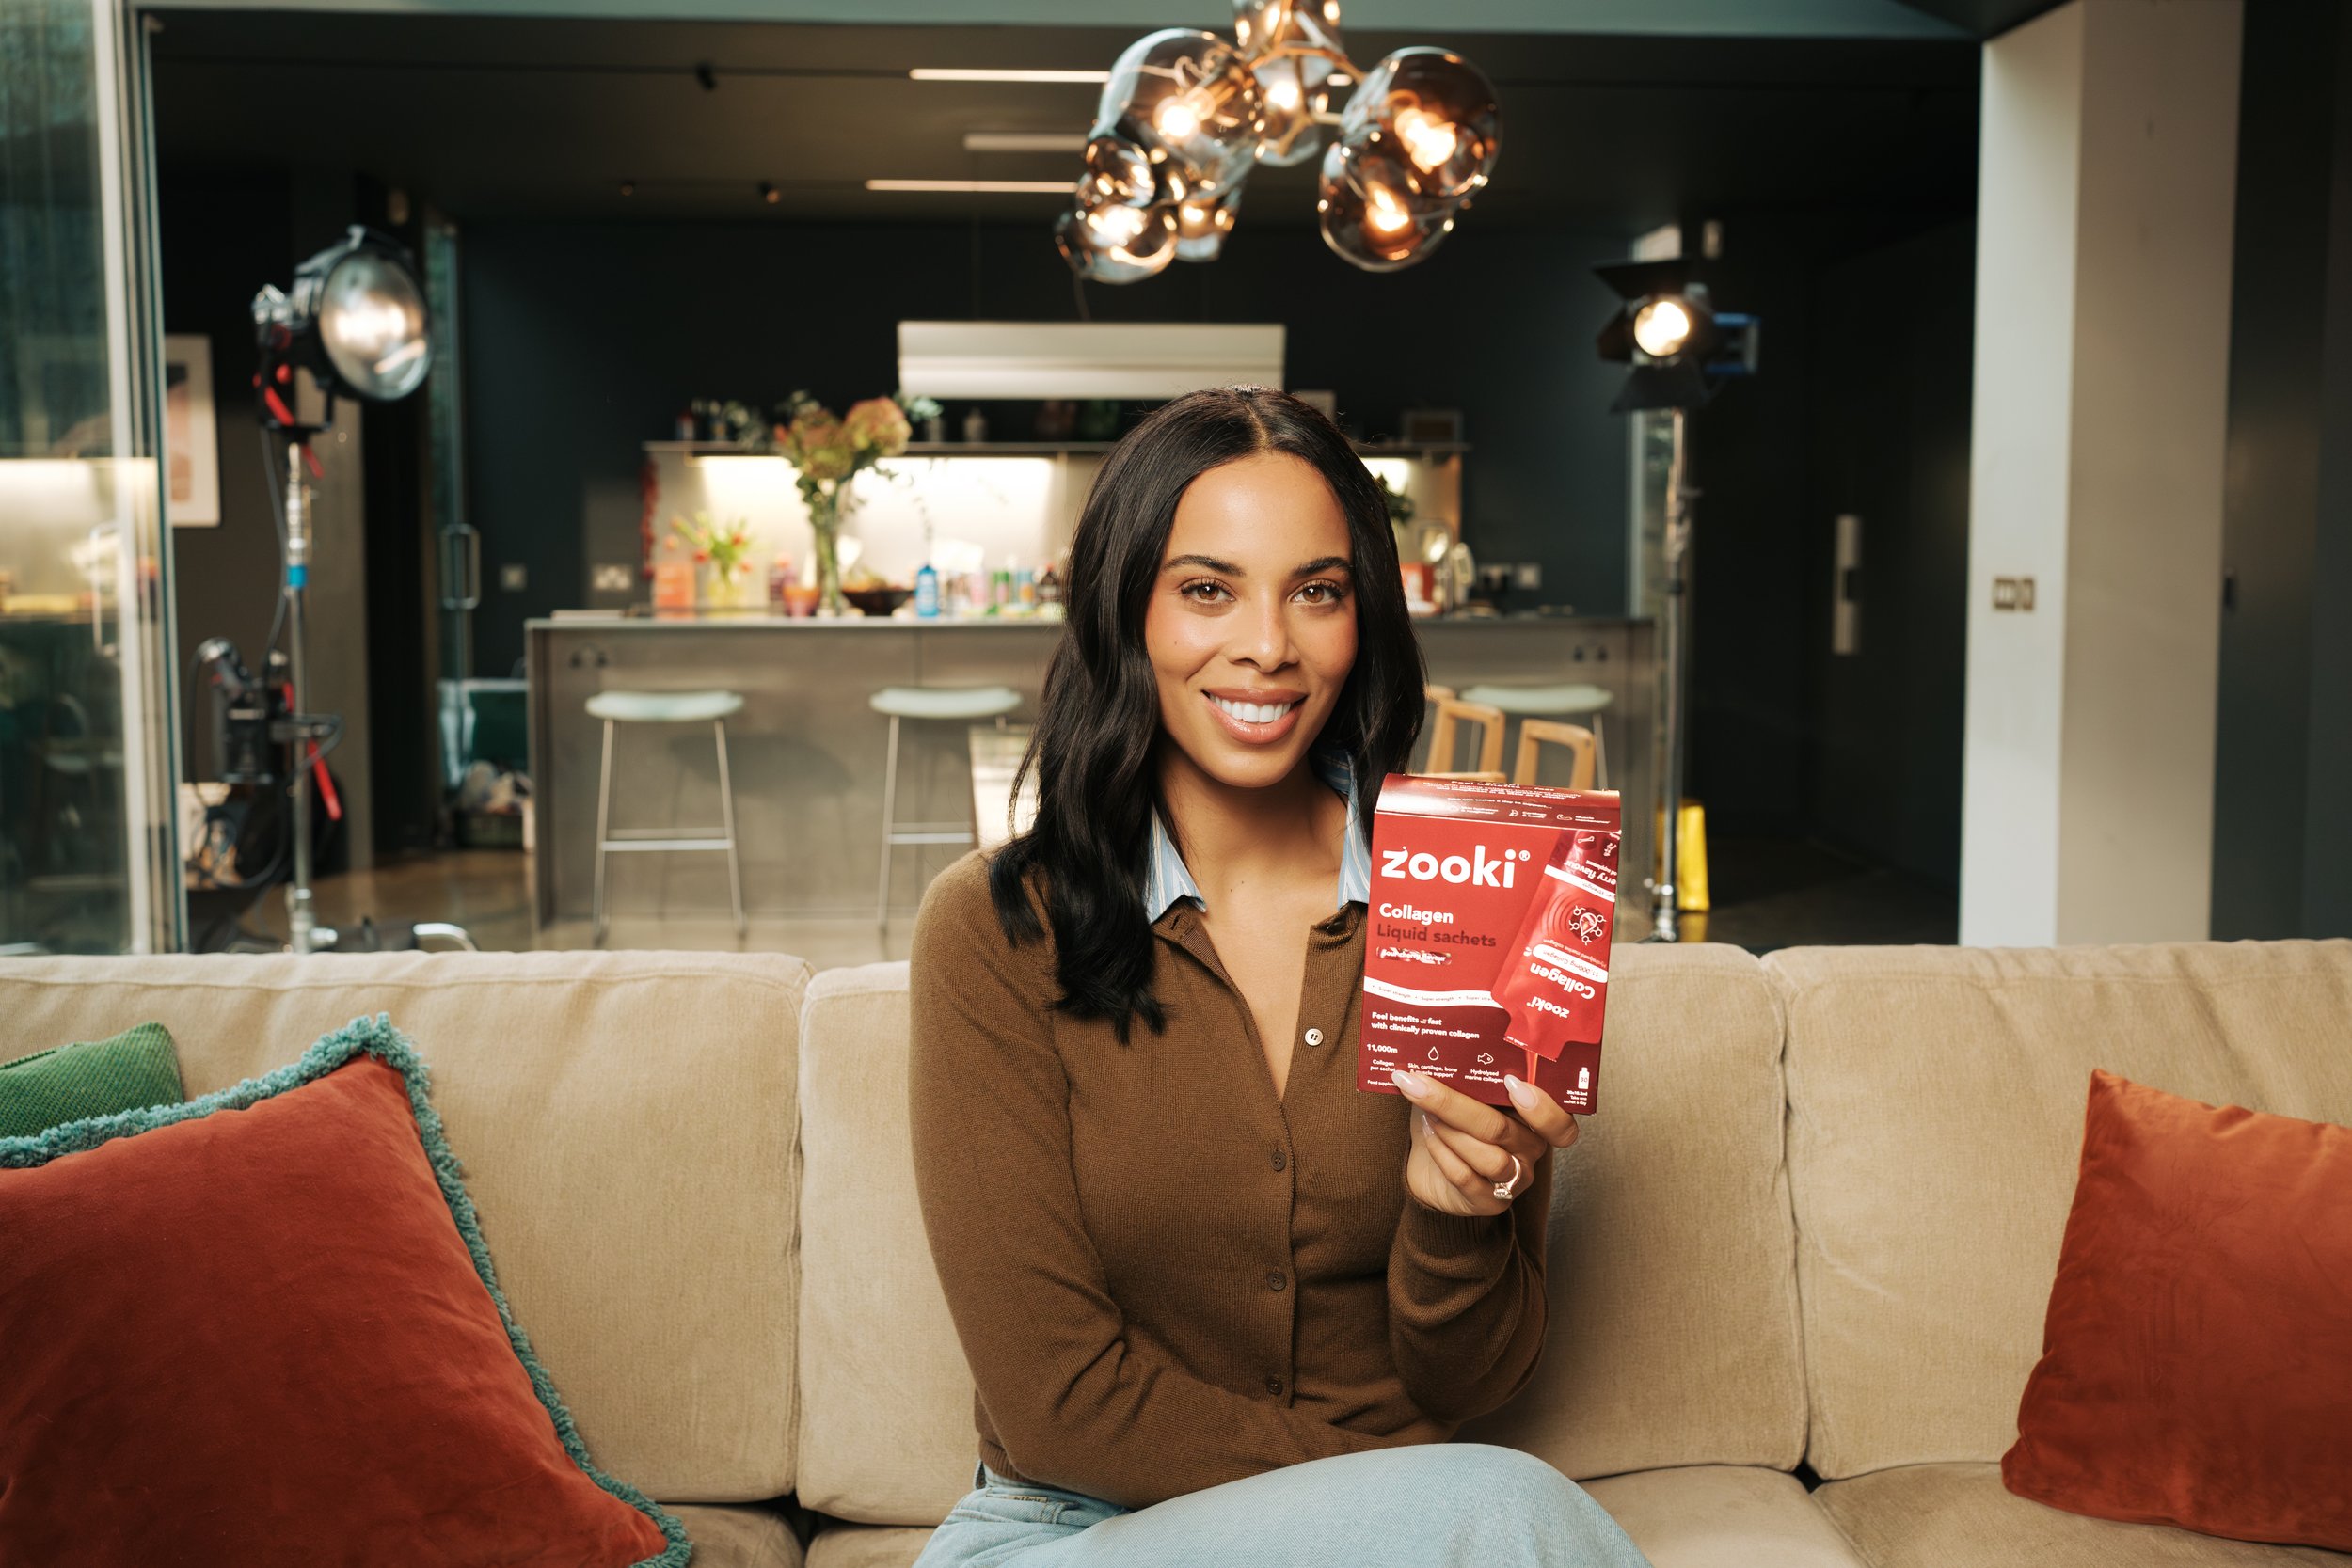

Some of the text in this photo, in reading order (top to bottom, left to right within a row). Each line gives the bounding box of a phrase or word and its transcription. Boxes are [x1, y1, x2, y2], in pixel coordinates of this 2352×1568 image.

[1564, 860, 1597, 879] flavour
[1379, 902, 1454, 926] Collagen
[1377, 923, 1497, 947] Liquid sachets
[1543, 951, 1600, 978] 11,000mg Collagen
[1530, 962, 1596, 1000] Collagen
[1372, 1011, 1442, 1026] Feel benefits fast
[1371, 1022, 1480, 1039] with clinically proven collagen
[1372, 1058, 1395, 1068] Collagen
[1407, 1062, 1420, 1070] Skin,
[1444, 1065, 1458, 1073] bone
[1470, 1069, 1500, 1078] Hydrolysed
[1482, 1075, 1504, 1084] collagen
